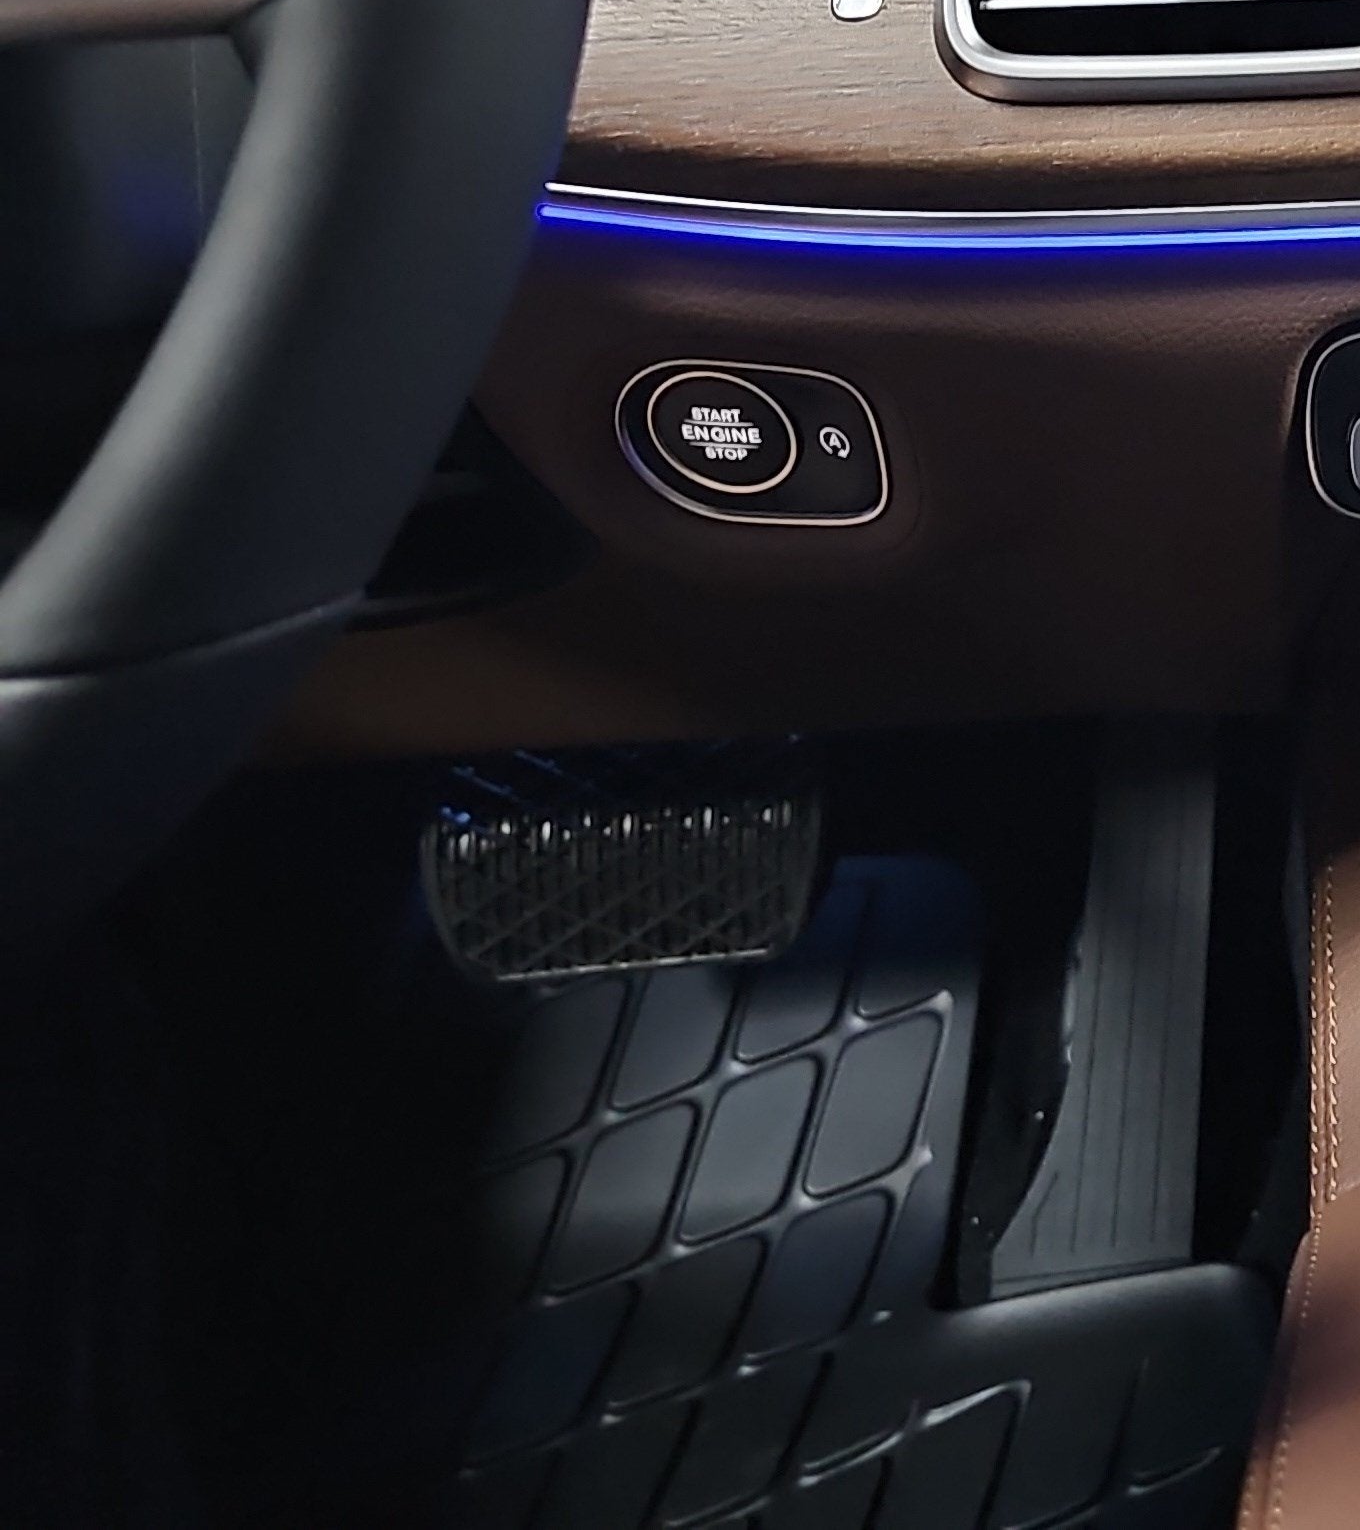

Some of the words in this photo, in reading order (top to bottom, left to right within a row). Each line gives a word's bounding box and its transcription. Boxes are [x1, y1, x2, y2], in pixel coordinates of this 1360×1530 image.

[691, 406, 742, 423] START
[681, 423, 763, 444] ENGINE
[704, 447, 749, 461] STOP
